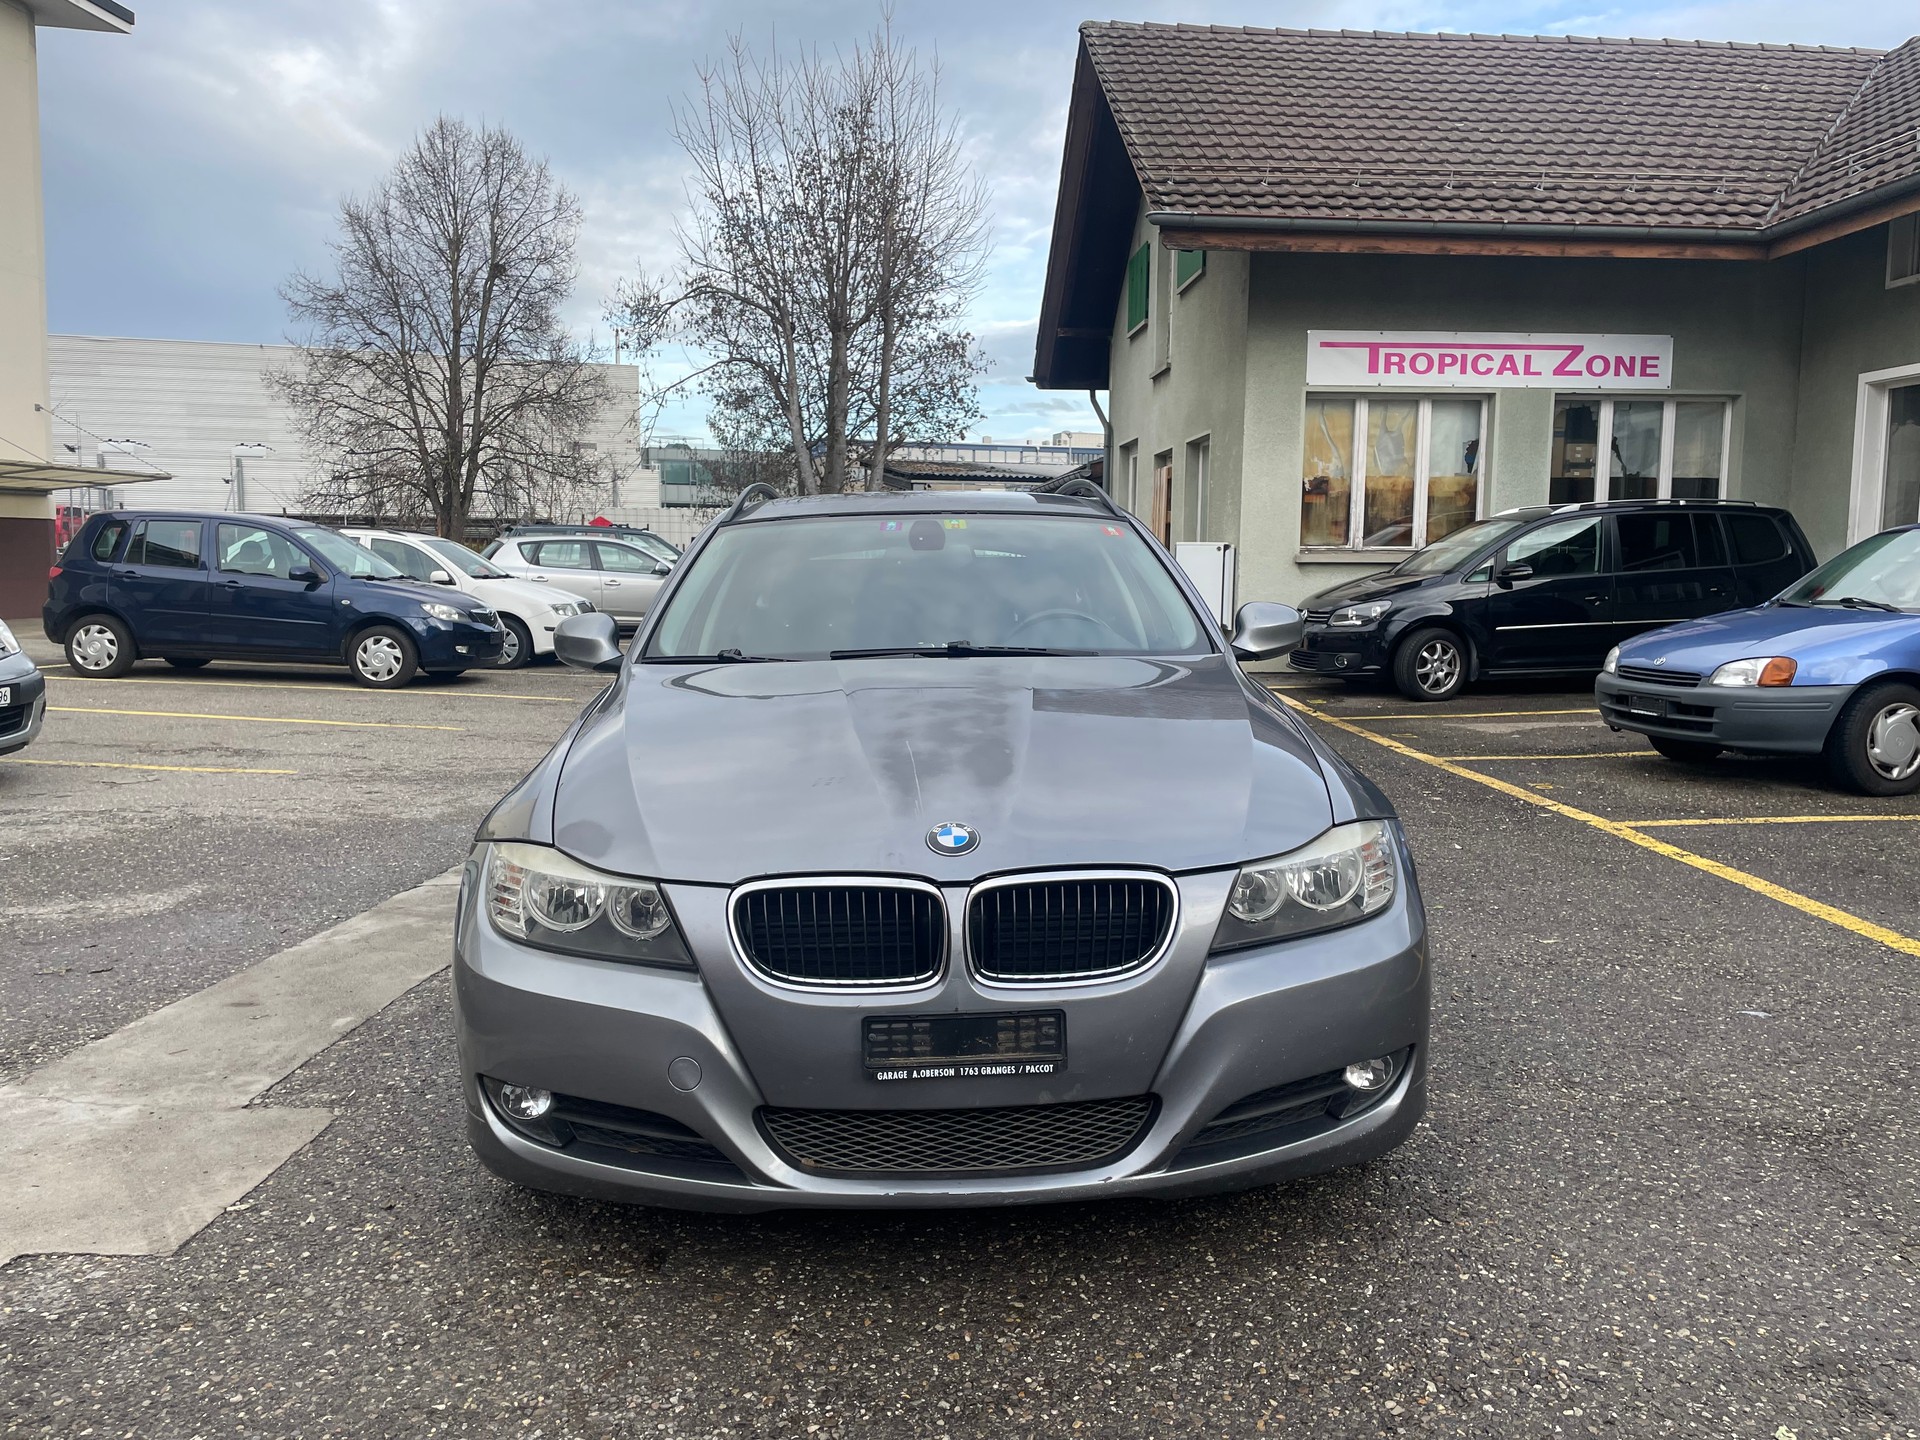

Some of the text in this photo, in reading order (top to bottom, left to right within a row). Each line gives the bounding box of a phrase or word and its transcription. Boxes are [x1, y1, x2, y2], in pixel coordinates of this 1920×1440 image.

[1320, 341, 1660, 378] TROPICAL ZONE
[932, 823, 973, 833] BMW
[877, 1070, 908, 1081] GARAGE
[912, 1068, 955, 1079] A.OBERSON
[960, 1067, 979, 1076] 1763
[981, 1066, 1016, 1075] GRANGES
[1025, 1064, 1054, 1073] PACCOT
